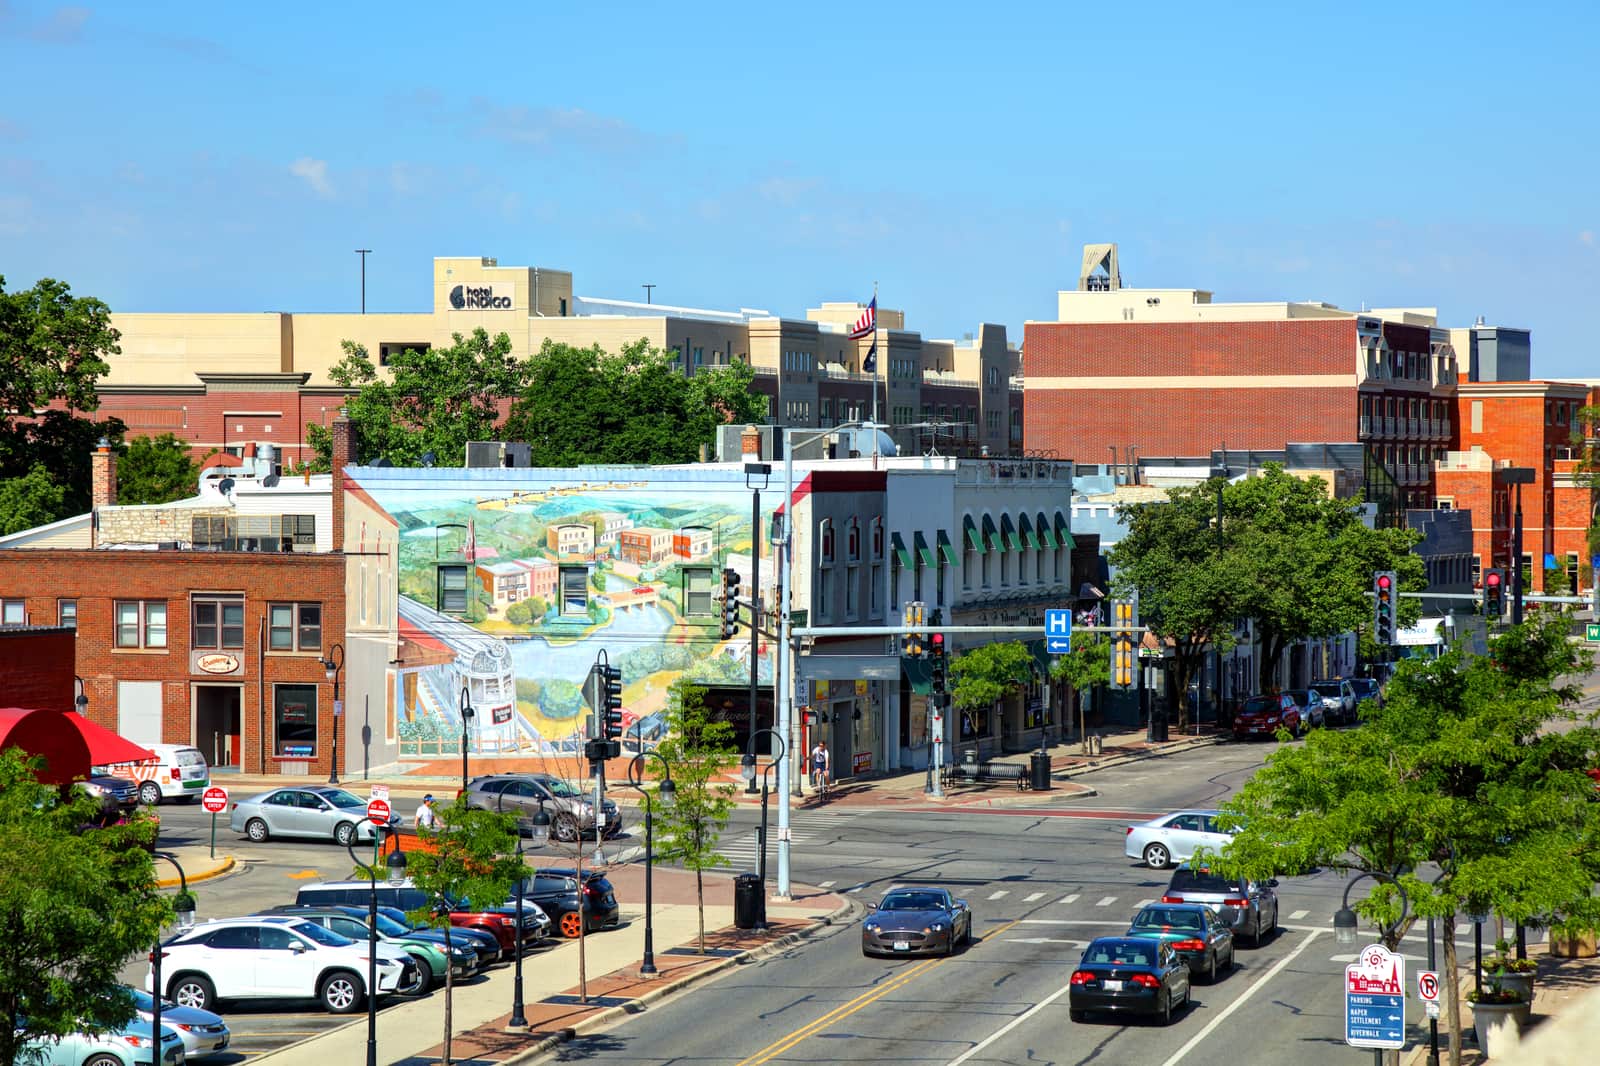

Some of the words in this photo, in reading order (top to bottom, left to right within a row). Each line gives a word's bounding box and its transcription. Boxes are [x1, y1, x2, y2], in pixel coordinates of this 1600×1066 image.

[466, 286, 492, 297] hotel
[466, 296, 512, 309] INDIGO
[1050, 613, 1066, 633] H
[1589, 627, 1599, 637] W
[1350, 996, 1373, 1005] PARKING
[1350, 1008, 1368, 1016] NAPER
[1350, 1016, 1382, 1025] SETTLEMENT
[1350, 1029, 1381, 1038] RIVERWALK
